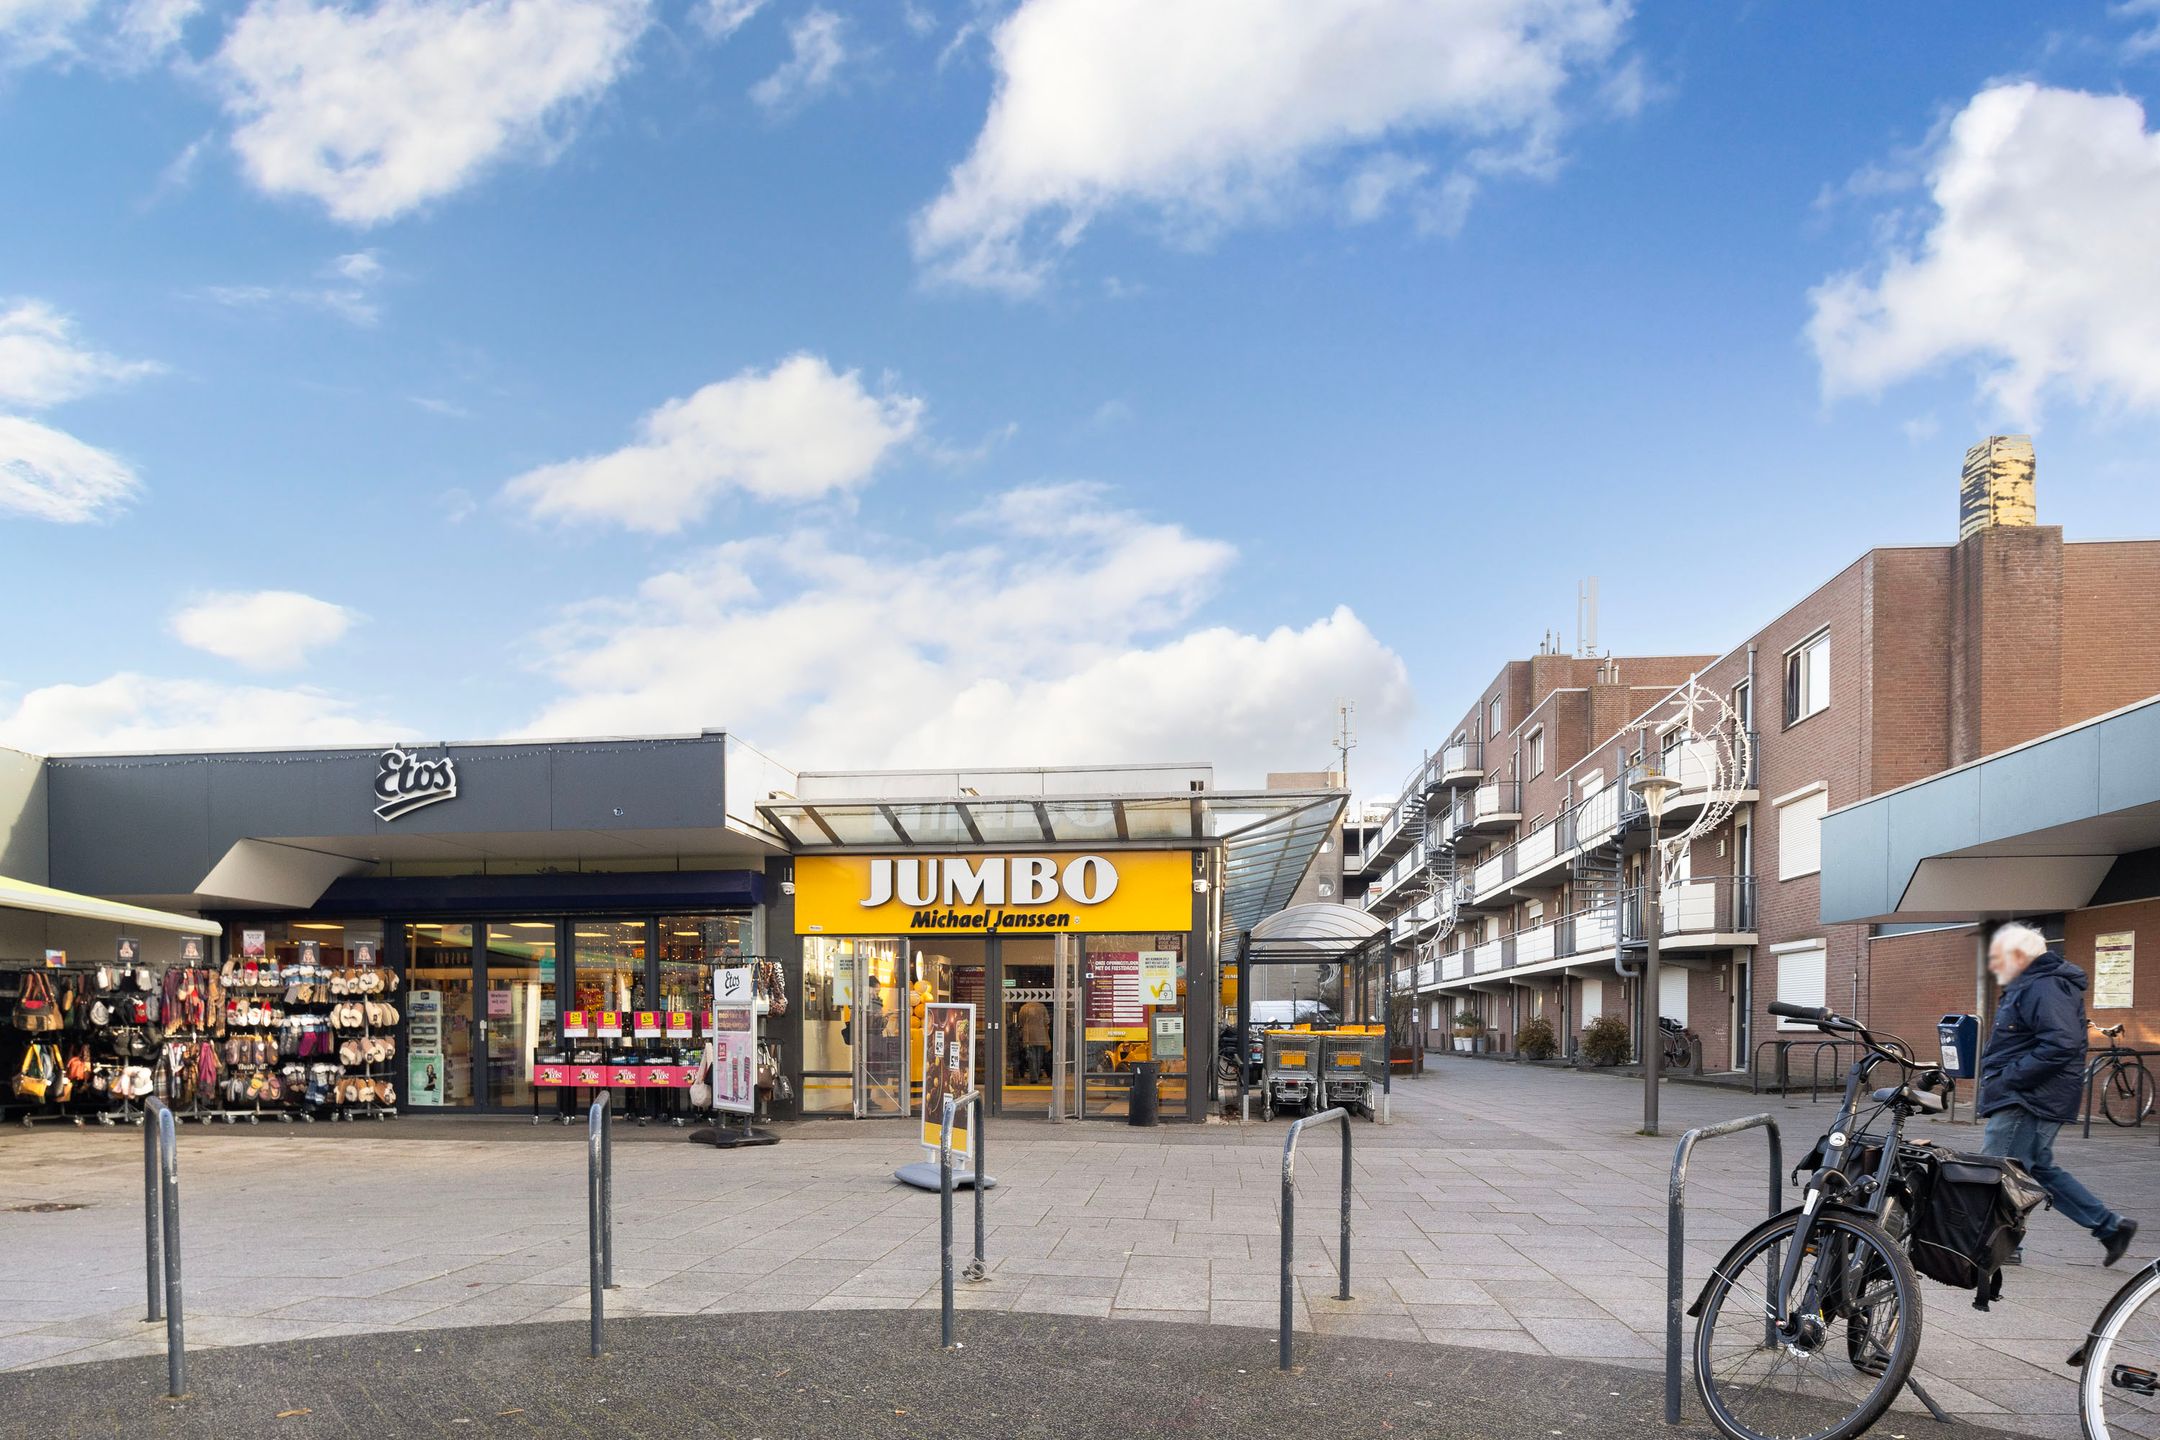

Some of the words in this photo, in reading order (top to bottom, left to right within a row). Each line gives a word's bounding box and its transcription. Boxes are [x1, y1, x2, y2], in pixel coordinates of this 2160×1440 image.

[374, 744, 456, 804] Etos
[859, 855, 1119, 907] JUMBO
[910, 910, 989, 929] Michael
[992, 910, 1070, 929] Janssen
[725, 971, 740, 989] Etos
